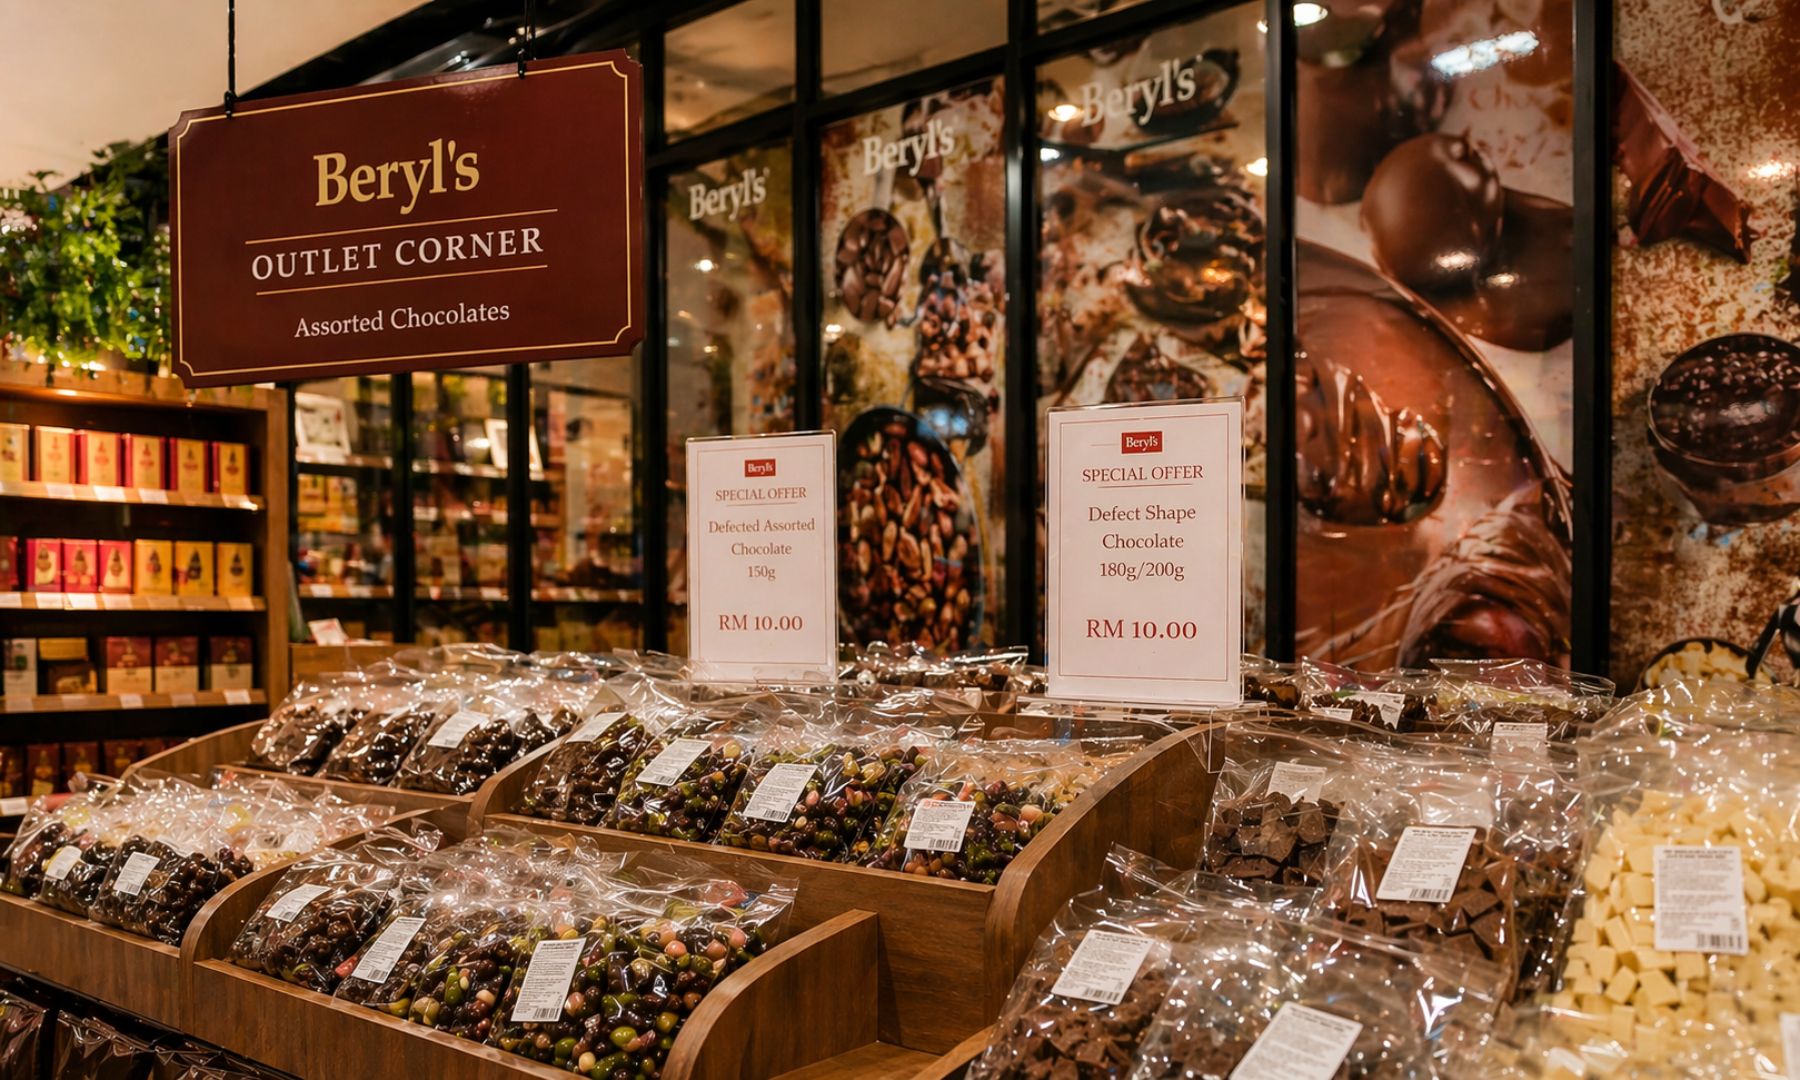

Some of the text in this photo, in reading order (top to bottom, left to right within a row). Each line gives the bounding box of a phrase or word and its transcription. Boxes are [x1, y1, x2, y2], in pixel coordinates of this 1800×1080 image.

[1080, 57, 1197, 126] Beryl's
[863, 118, 956, 177] Beryl's
[313, 138, 480, 215] Beryl's
[688, 167, 767, 221] Beryl's
[251, 227, 544, 281] OUTLET CORNER
[294, 302, 510, 338] Assorted Chocolates
[1125, 435, 1158, 452] Beryl's
[1082, 465, 1204, 482] SPECIAL OFFER
[715, 487, 807, 502] SPECIAL OFFER
[1088, 504, 1196, 524] Defect Shape
[708, 517, 815, 534] Defected Assorted
[731, 542, 792, 556] Chocolate
[1102, 533, 1184, 549] Chocolate
[747, 565, 776, 581] 150g
[1099, 561, 1185, 581] 180g/200g
[719, 614, 803, 631] RM 10.00
[1086, 619, 1197, 639] RM 10.00
